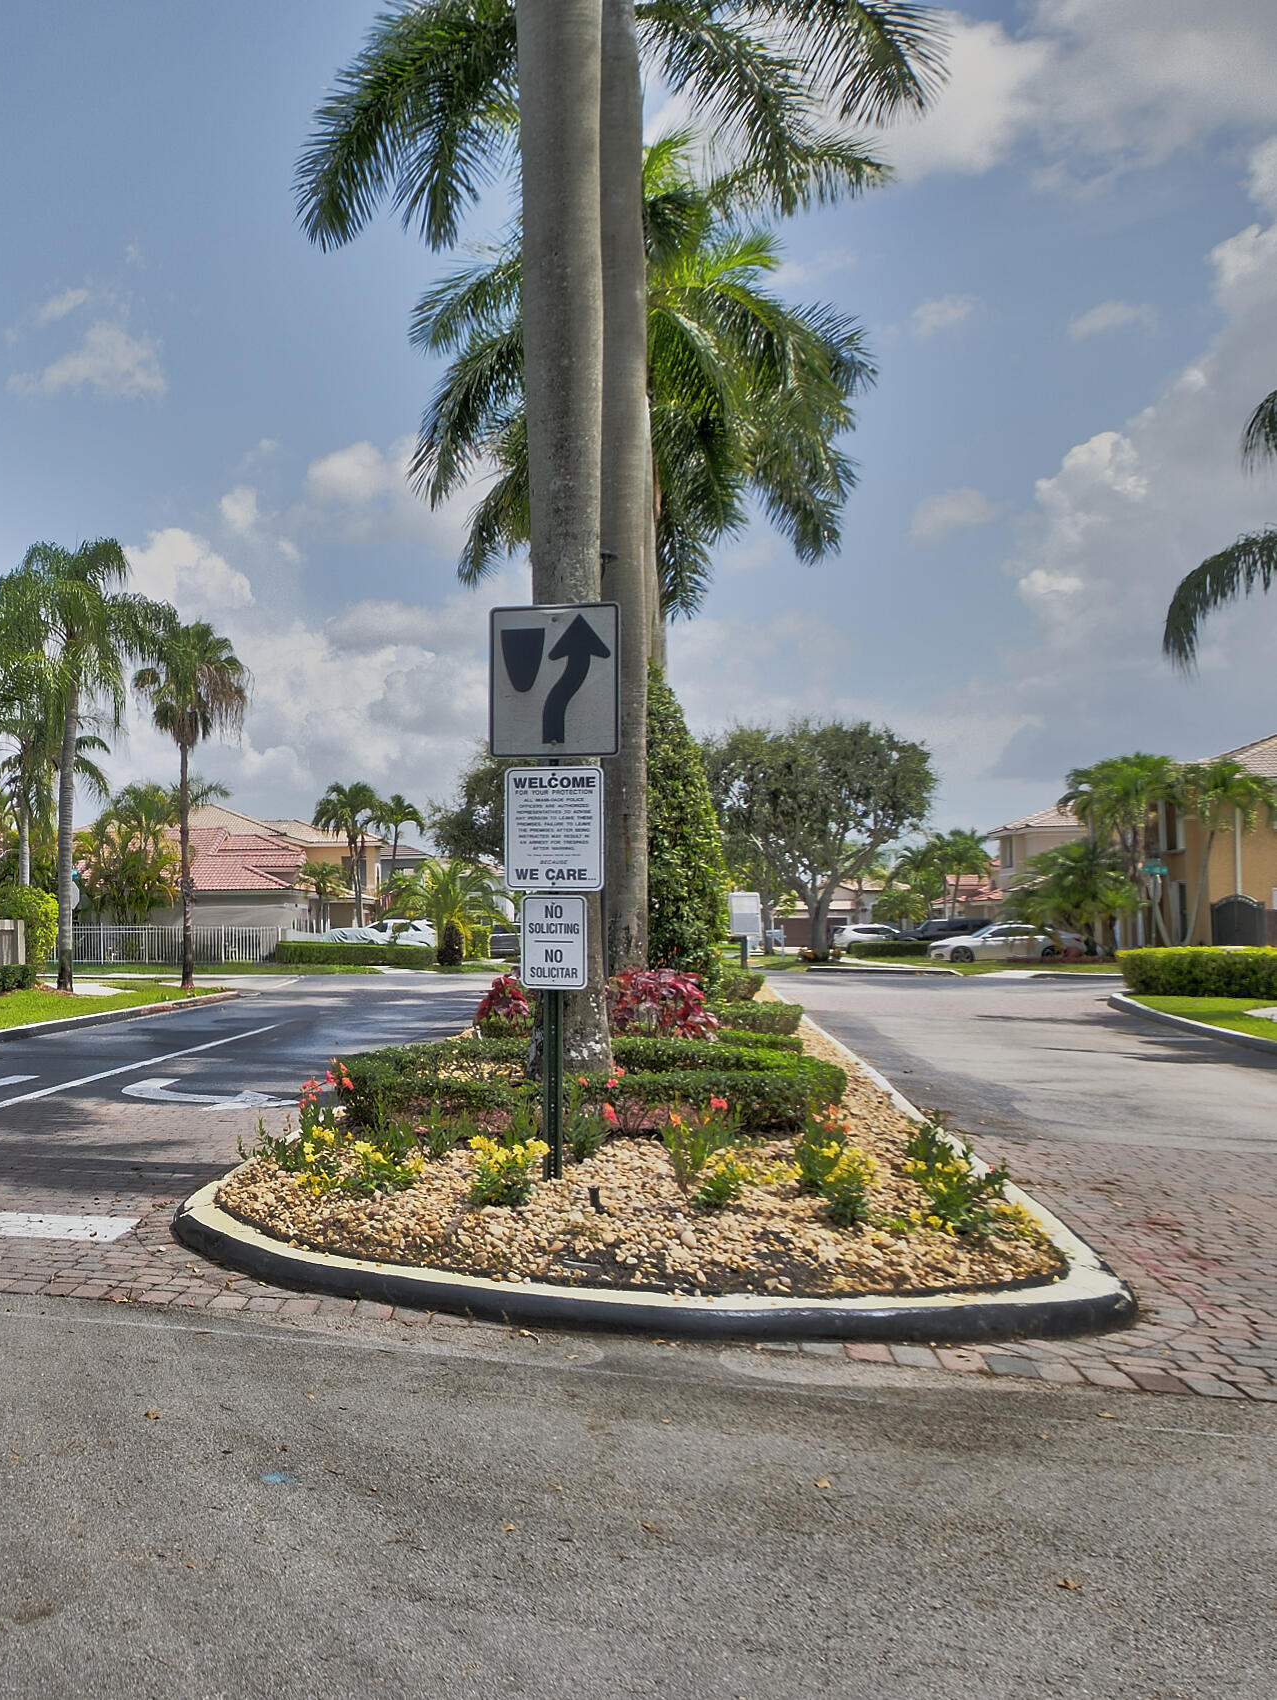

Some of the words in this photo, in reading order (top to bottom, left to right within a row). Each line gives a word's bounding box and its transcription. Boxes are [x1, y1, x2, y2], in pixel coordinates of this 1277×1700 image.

[513, 776, 596, 789] WELCOME
[515, 868, 539, 880] WE
[544, 905, 563, 919] NO
[528, 923, 580, 934] SOLICITING
[544, 949, 563, 963] NO
[530, 967, 578, 978] SOLICITAR
